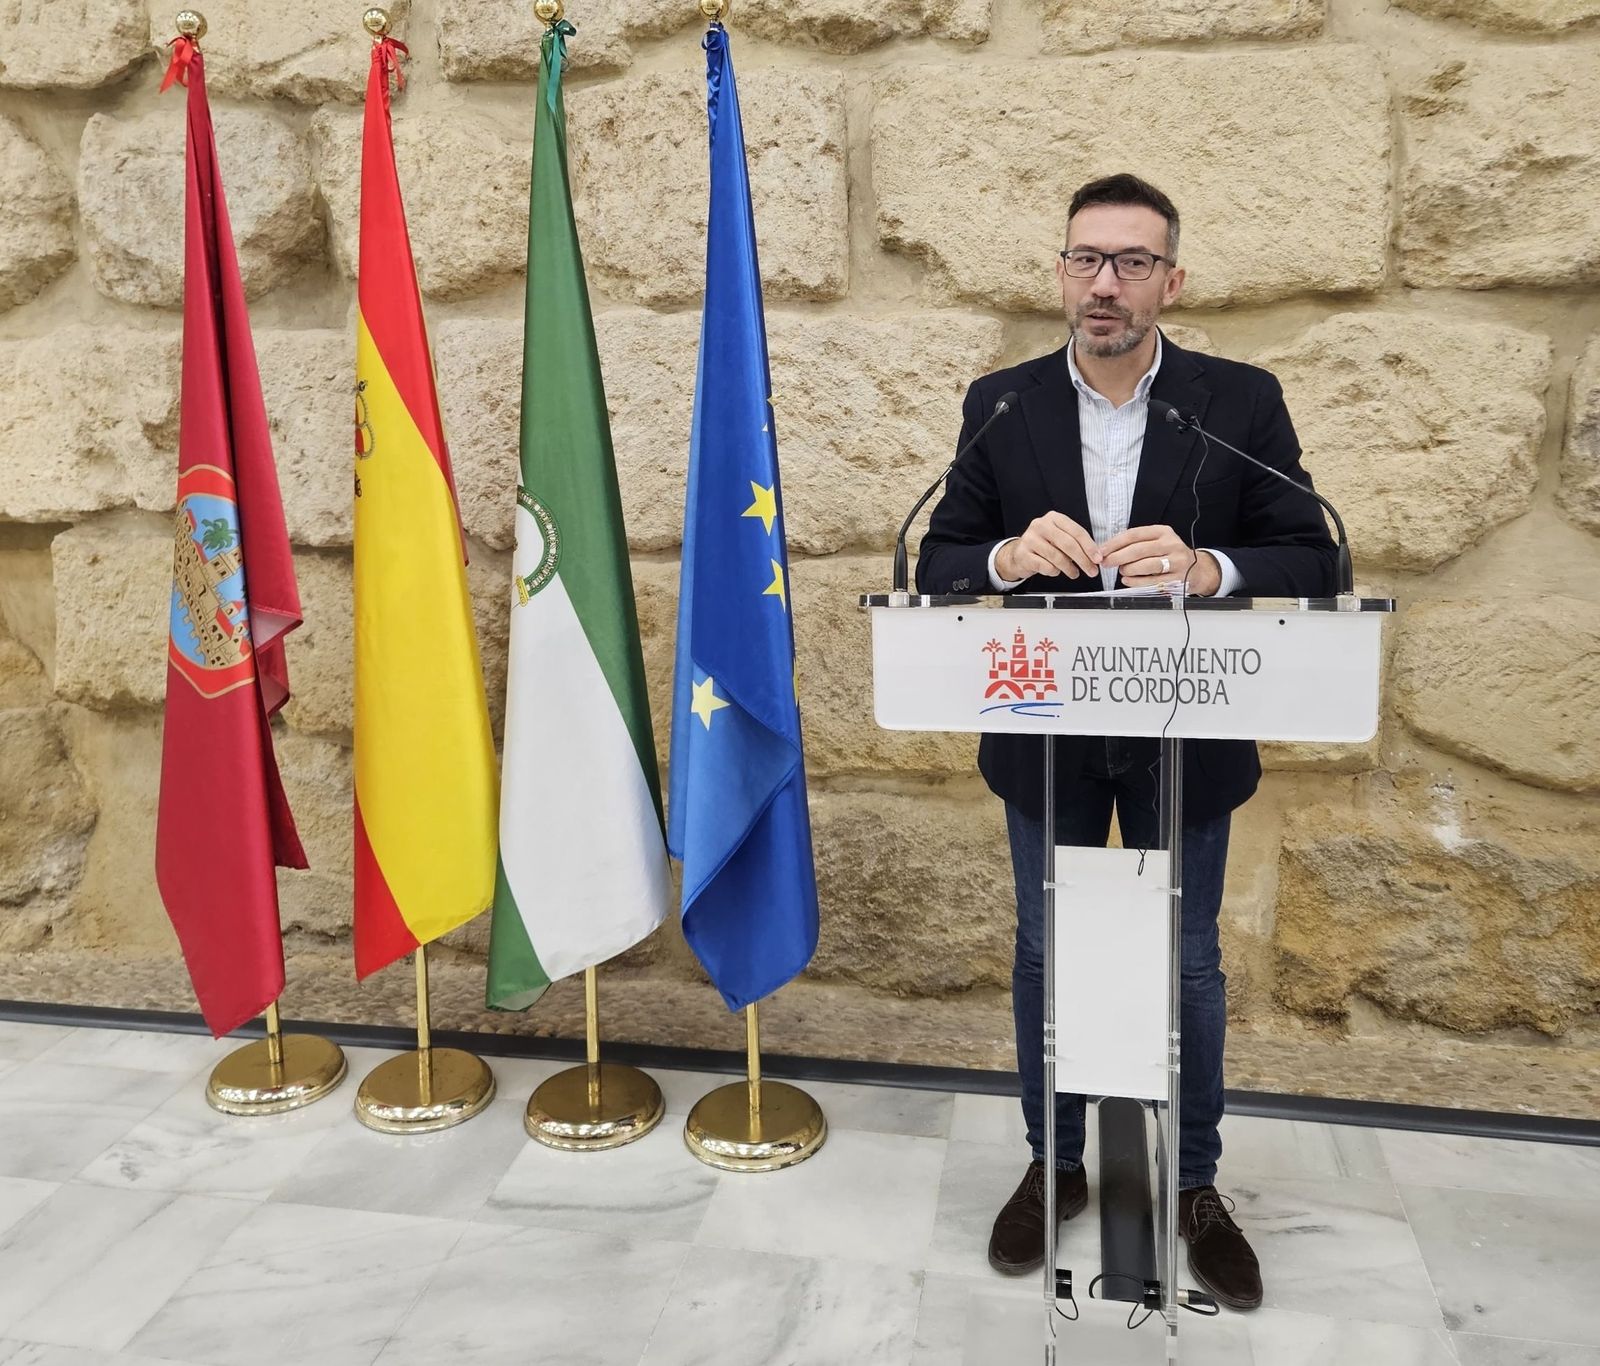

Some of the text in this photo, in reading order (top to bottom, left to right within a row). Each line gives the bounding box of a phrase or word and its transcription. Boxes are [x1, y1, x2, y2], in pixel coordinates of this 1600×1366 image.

[1071, 646, 1262, 675] AYUNTAMIENTO
[1071, 673, 1230, 705] DE CÓRDOBA
